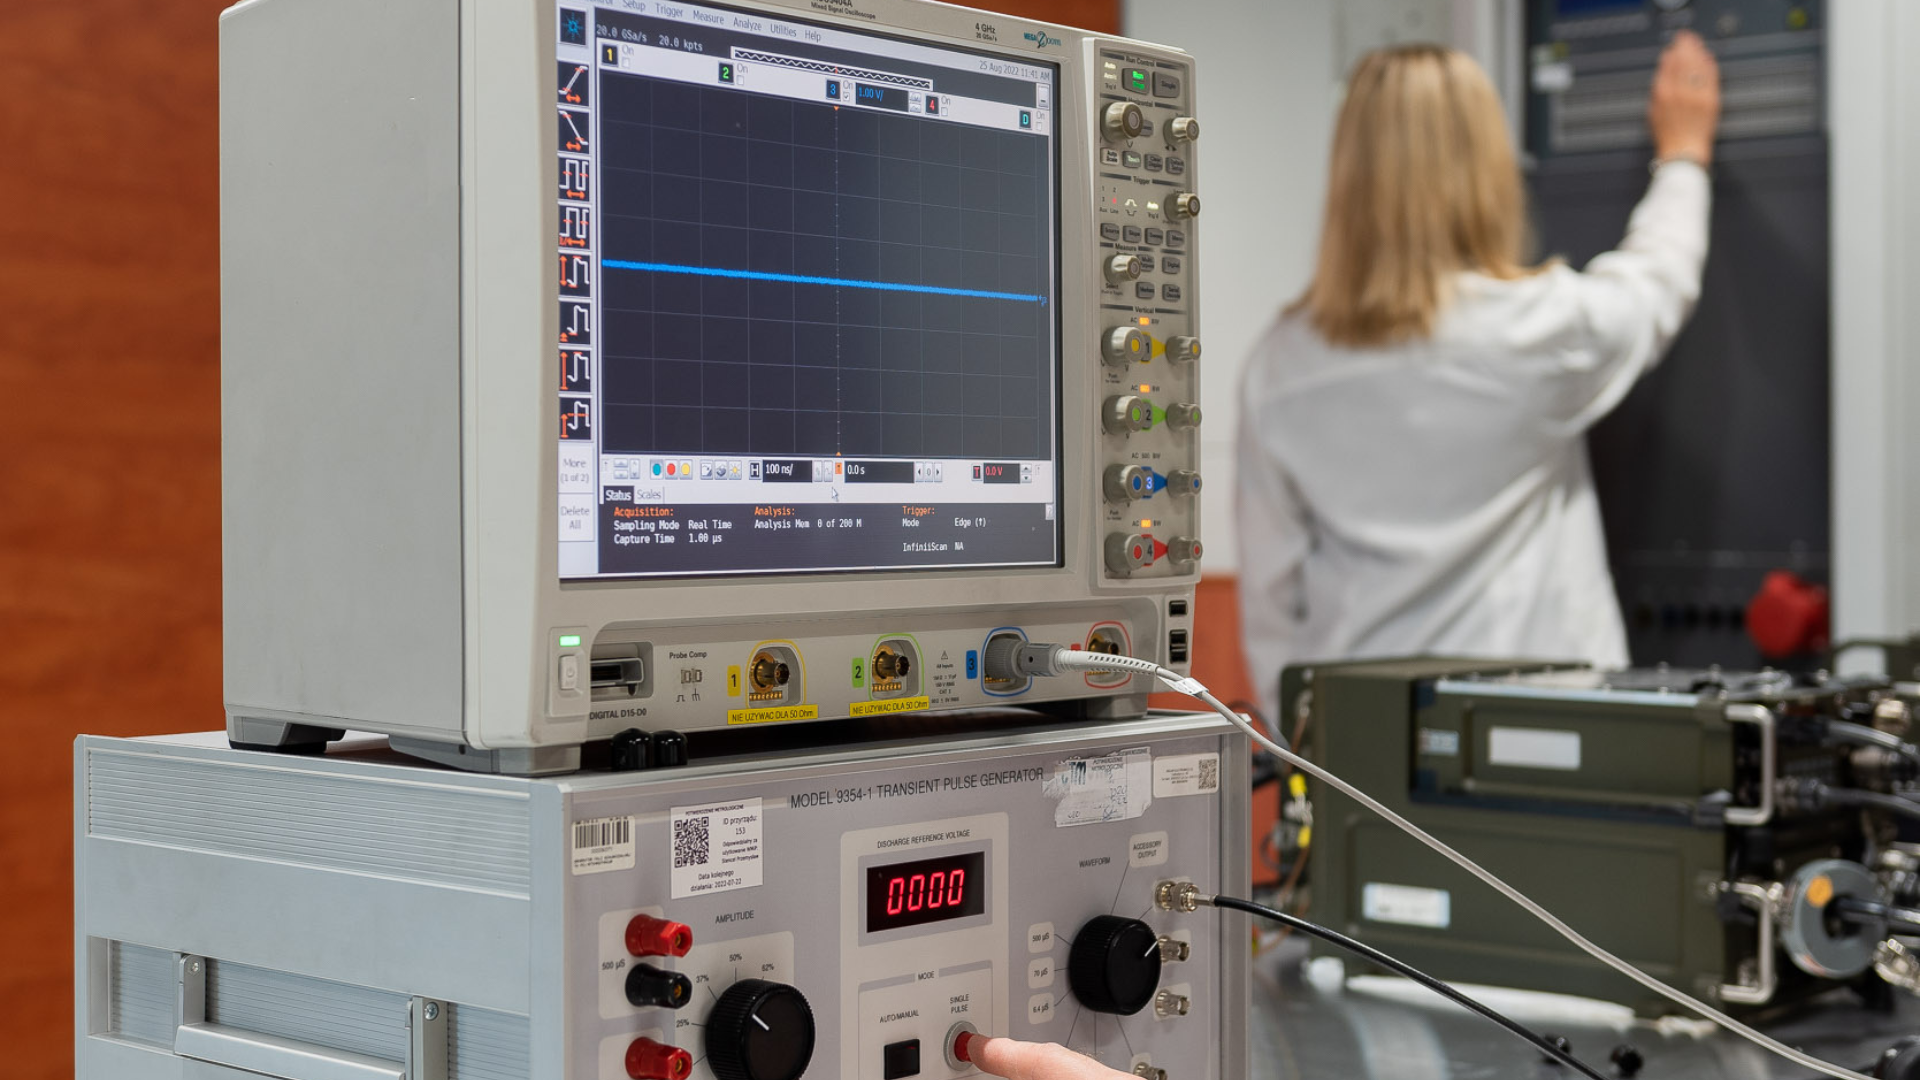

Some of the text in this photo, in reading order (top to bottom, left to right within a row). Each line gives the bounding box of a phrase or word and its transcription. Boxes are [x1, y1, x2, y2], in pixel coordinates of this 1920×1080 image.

[623, 0, 821, 42] Setup Trigger Measure Analyze Utilities Help
[976, 23, 996, 34] 4 GHz
[596, 24, 702, 52] 20.0 GSa/s 20.0 kpts
[608, 48, 613, 60] 1
[622, 45, 634, 56] On
[722, 67, 729, 78] 2
[737, 64, 748, 73] On
[980, 60, 1050, 80] 25 Aug 2022 11:41 AM
[830, 84, 836, 96] 3
[843, 81, 853, 90] On
[858, 87, 873, 99] 1.00
[929, 99, 935, 110] 4
[941, 96, 950, 105] On
[1023, 114, 1029, 124] D
[1036, 111, 1045, 120] On
[1133, 176, 1150, 185] Trigger
[1115, 243, 1136, 251] Measure
[1145, 342, 1149, 354] 1
[1146, 410, 1151, 420] 2
[563, 459, 586, 468] More
[750, 464, 759, 476] H
[765, 463, 794, 476] 100 ns/
[848, 465, 865, 475] 0.0 s
[974, 467, 980, 478] T
[985, 466, 1003, 476] 0.0 V
[560, 473, 589, 484] (1 of 2)
[1146, 477, 1152, 489] 3
[606, 490, 632, 501] Status
[637, 489, 661, 499] Scales
[561, 506, 590, 516] Delete
[614, 507, 674, 518] Acquisition:
[754, 506, 795, 517] Analysis:
[902, 505, 935, 516] Trigger:
[569, 520, 581, 529] All
[614, 520, 680, 532] Sampling Mode
[688, 520, 732, 529] Real Time
[754, 519, 862, 530] Analysis Mem 0 of 200 M
[902, 518, 919, 527] Mode
[954, 518, 971, 529] Edge
[614, 534, 675, 546] Capture Time
[689, 533, 709, 543] 1.00
[903, 542, 964, 552] InfiniiScan NA
[1147, 544, 1152, 556] 4
[669, 651, 707, 660] Probe Comp
[969, 658, 974, 670] 3
[855, 666, 861, 678] 2
[731, 674, 736, 688] 1
[590, 708, 647, 720] DIGITAL D15-D0
[853, 706, 863, 714] NIE
[732, 713, 743, 722] NIE
[745, 711, 774, 721] UZYWAC
[775, 711, 788, 719] DLA
[790, 710, 797, 718] 50
[791, 767, 1044, 809] MODEL 9354-1 TRANSIENT PULSE GENERATOR
[736, 827, 746, 835] 153
[877, 829, 971, 849] DISCHARGE REFERENCE VOLTAGE
[1133, 840, 1162, 850] ACCESSORY
[1138, 850, 1157, 859] OUTPUT
[1079, 857, 1111, 868] WAVEFORM
[711, 870, 734, 878] kolejnego
[887, 869, 965, 915] 0000
[715, 910, 754, 924] AMPLITUDE
[1032, 934, 1042, 942] 500
[729, 953, 742, 962] 50%
[602, 961, 615, 971] 500
[762, 963, 774, 972] 62%
[696, 974, 709, 984] 37%
[918, 971, 935, 980] MODE
[1033, 970, 1040, 978] 70
[950, 994, 969, 1004] SINGLE
[951, 1004, 968, 1014] PULSE
[879, 1010, 920, 1024] AUTO/MANUAL
[676, 1018, 689, 1028] 25%
